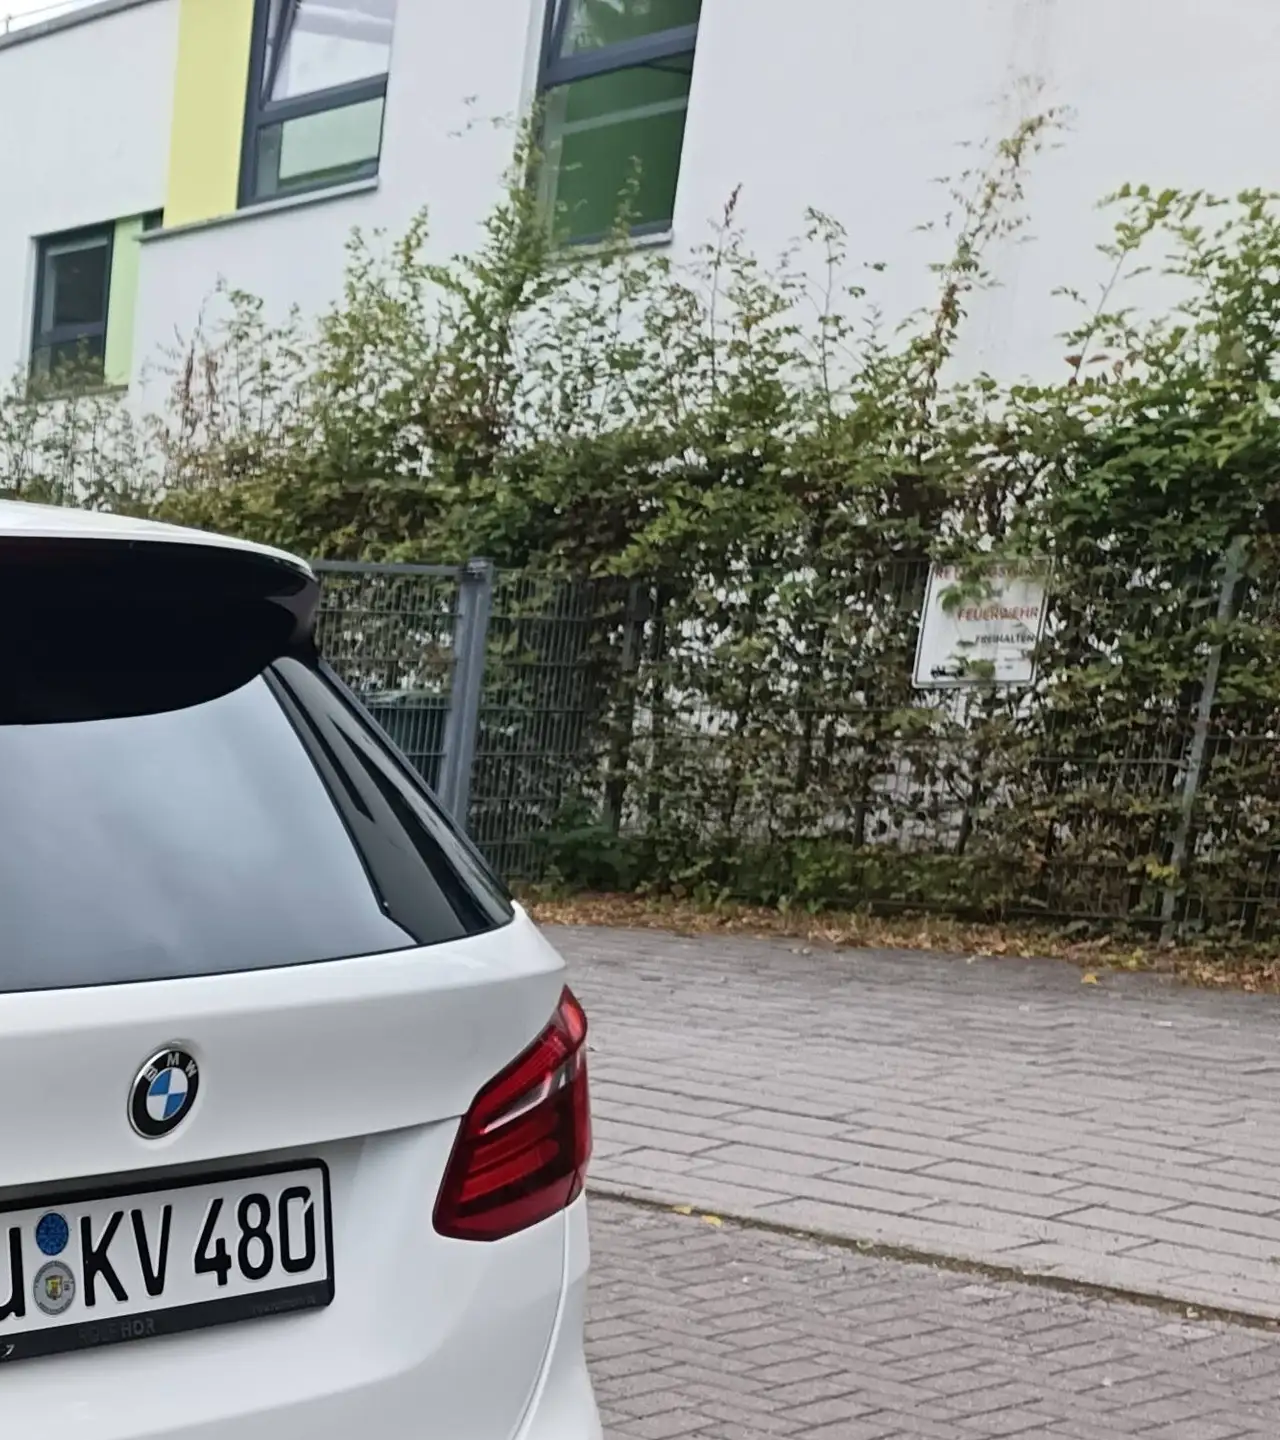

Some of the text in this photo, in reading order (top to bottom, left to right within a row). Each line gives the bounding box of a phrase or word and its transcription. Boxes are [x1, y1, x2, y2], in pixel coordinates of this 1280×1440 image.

[957, 605, 1038, 621] FEUERWEHR
[143, 1051, 198, 1082] BMW
[80, 1204, 173, 1307] KV
[194, 1186, 316, 1286] 480
